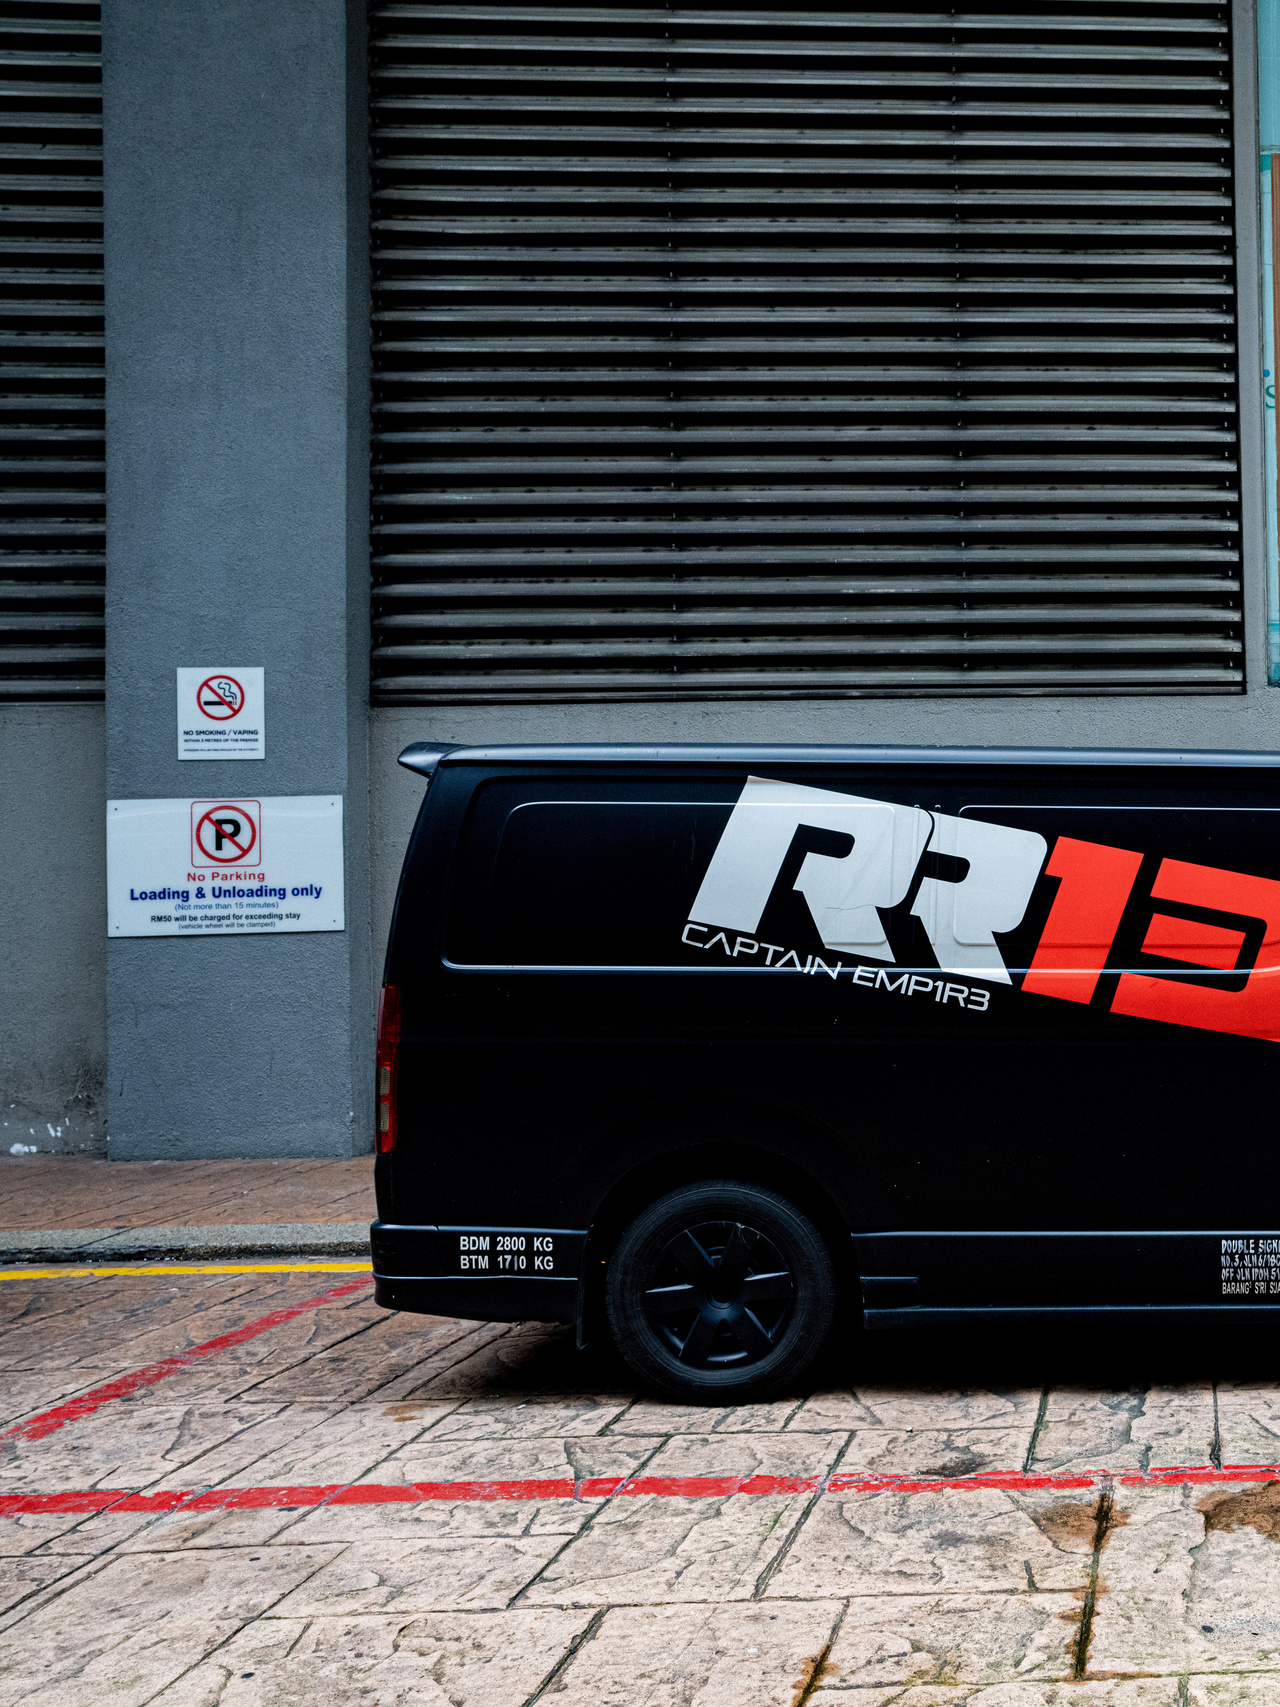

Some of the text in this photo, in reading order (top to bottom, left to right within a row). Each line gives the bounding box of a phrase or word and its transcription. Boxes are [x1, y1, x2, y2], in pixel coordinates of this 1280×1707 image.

[187, 871, 266, 882] No Parking
[130, 884, 322, 902] Loading & Unloading only
[174, 903, 192, 912] (Not
[245, 901, 279, 910] minutes)
[151, 912, 301, 923] RM50 will be charged for exceeding stay
[178, 922, 203, 930] (vehicle
[246, 921, 276, 929] clamped)
[681, 923, 991, 1011] CAPTAIN EMP1R3
[460, 1236, 554, 1252] BDM 2800 KG
[1221, 1239, 1255, 1254] DOUBLE
[460, 1255, 554, 1271] BTM 1710 KG
[1221, 1268, 1235, 1281] OFF
[1236, 1268, 1251, 1281] JLN
[1252, 1268, 1270, 1281] IPOH
